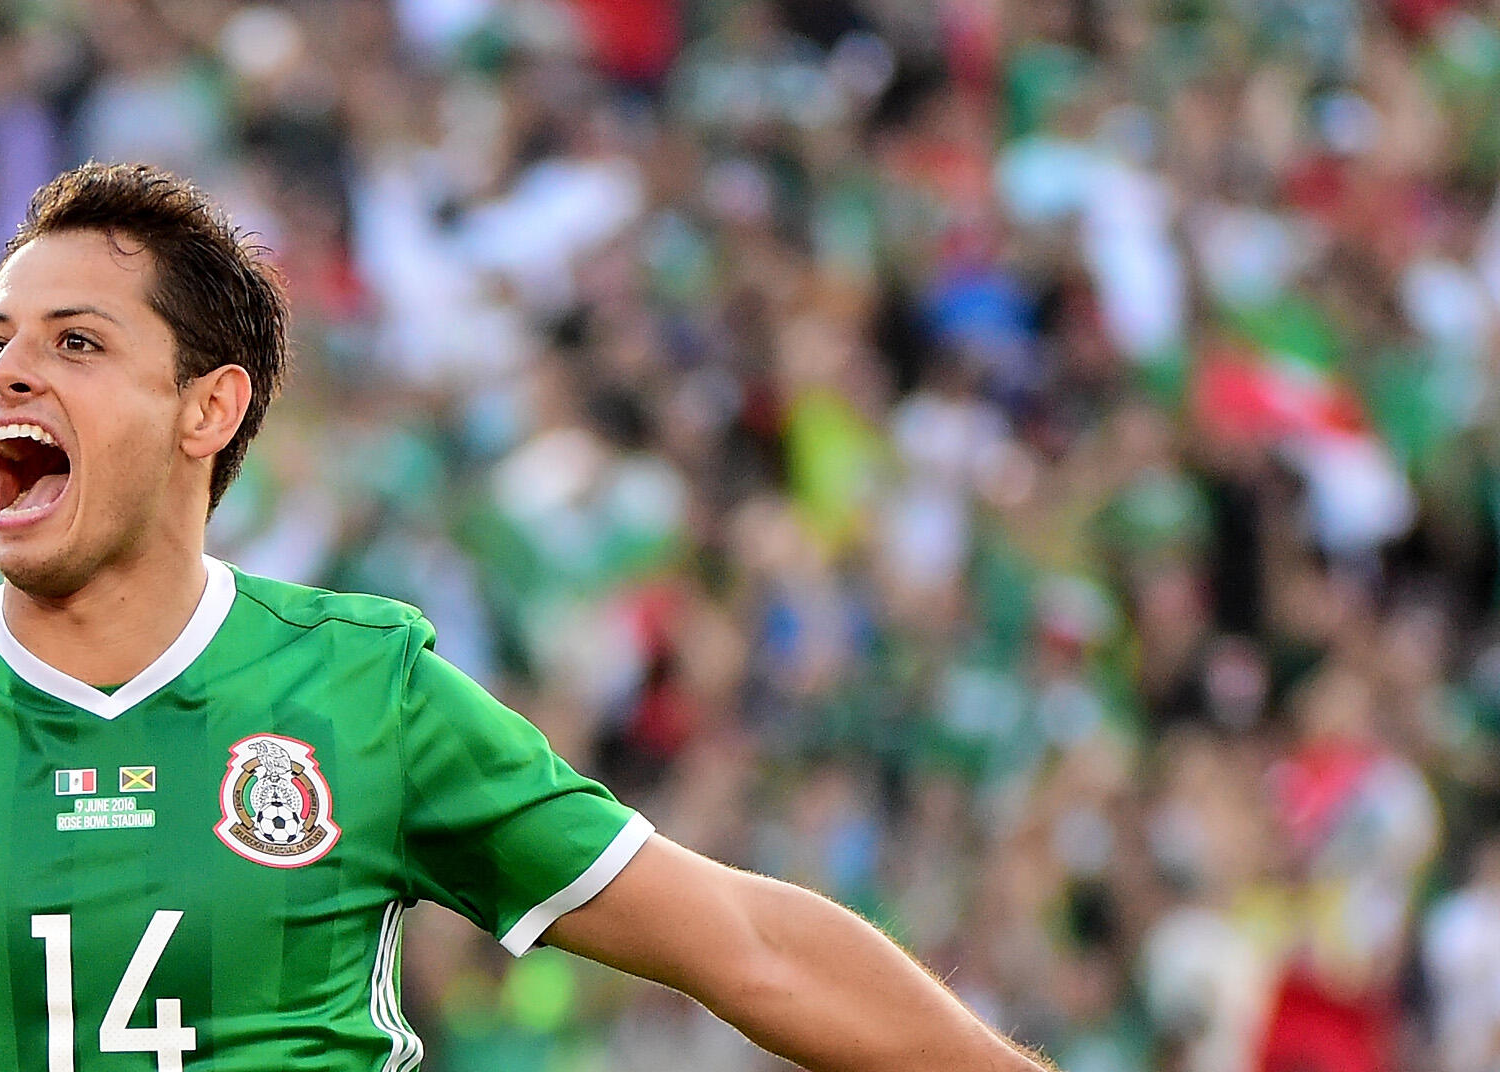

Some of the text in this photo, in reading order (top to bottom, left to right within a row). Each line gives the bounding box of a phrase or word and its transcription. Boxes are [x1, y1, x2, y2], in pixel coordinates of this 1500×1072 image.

[76, 798, 135, 813] 9 JUNE 2016
[58, 812, 153, 829] ROSE BOWL STADIUM
